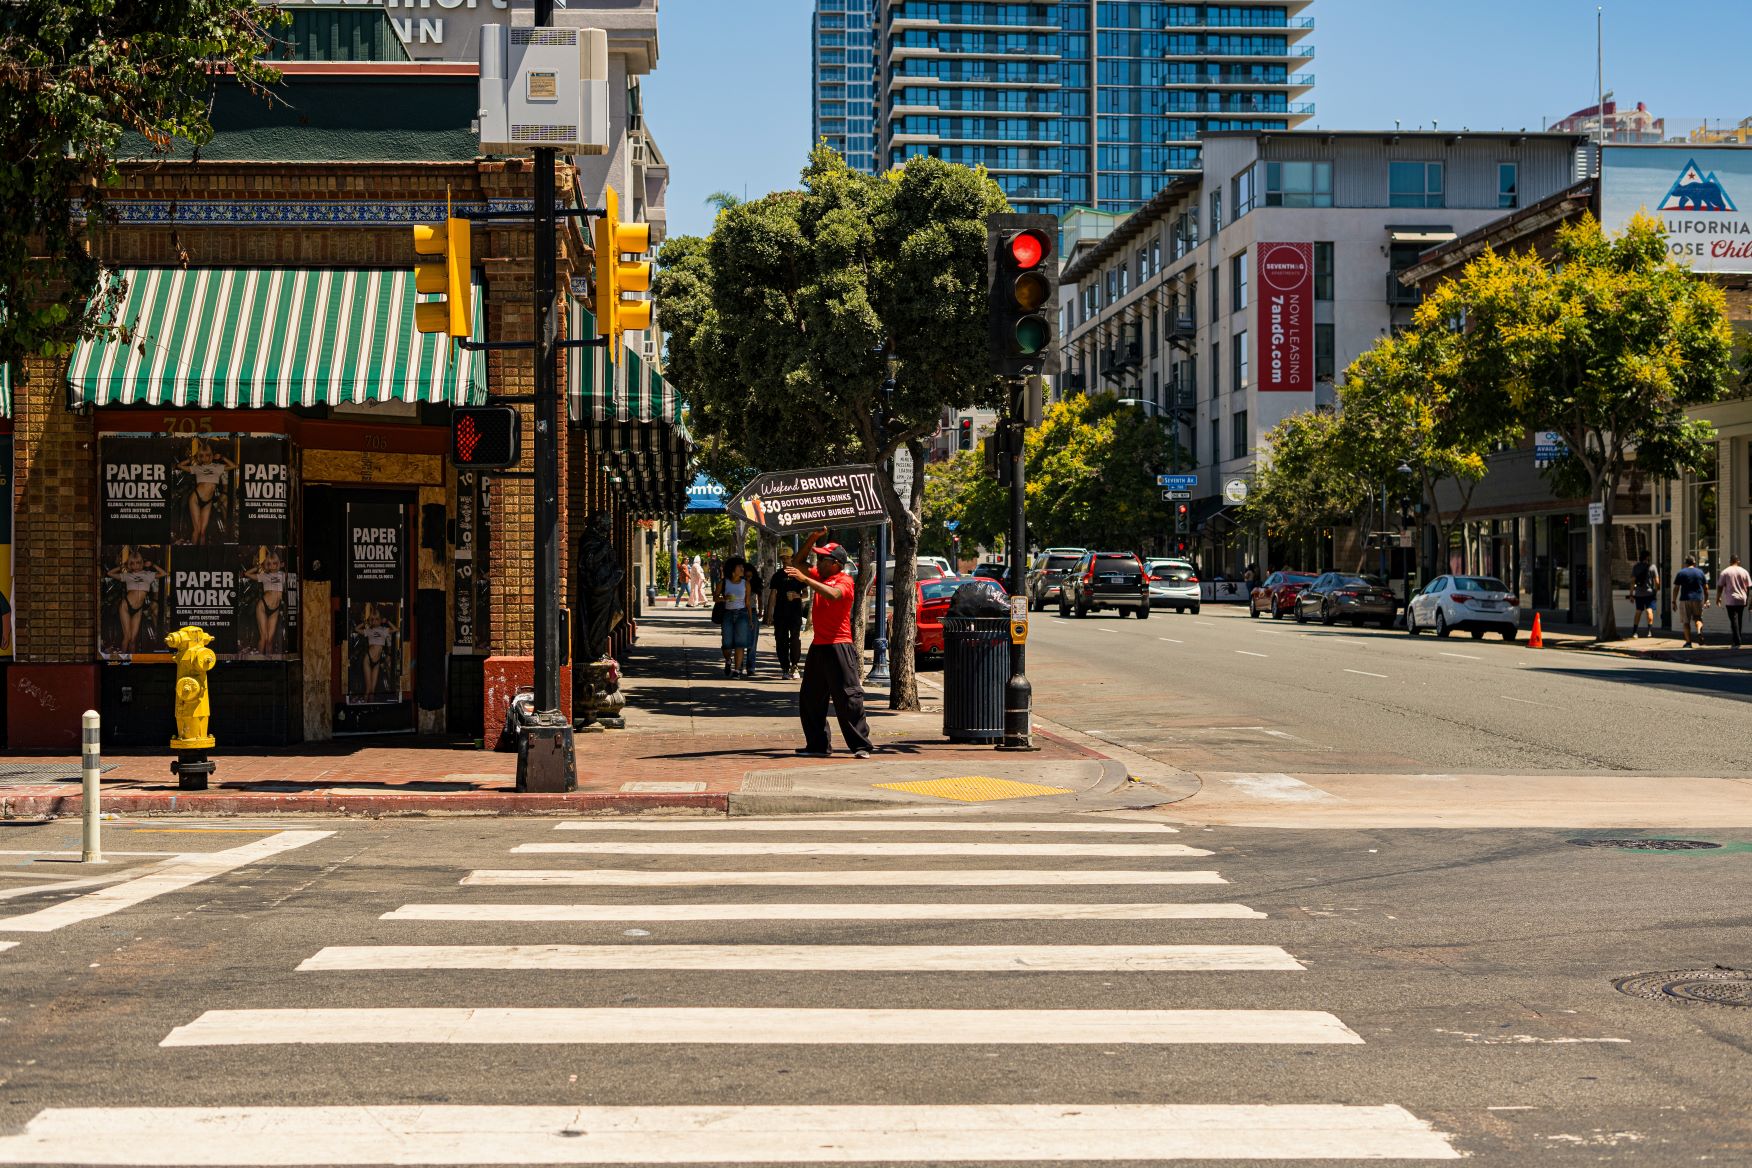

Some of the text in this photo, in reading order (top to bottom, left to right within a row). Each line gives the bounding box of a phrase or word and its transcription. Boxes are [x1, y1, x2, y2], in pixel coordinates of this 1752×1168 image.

[1272, 295, 1284, 382] 7andG.com
[1290, 294, 1300, 384] NOW LEASING
[106, 464, 166, 480] PAPER
[762, 476, 848, 495] Weekend BRUNCH
[850, 473, 882, 511] STK
[782, 497, 826, 508] BOTTOMLESS
[826, 494, 852, 502] DRINKS
[778, 507, 855, 526] $9.99 WAGYU BURGER
[353, 528, 396, 543] PAPER
[175, 571, 234, 588] PAPER
